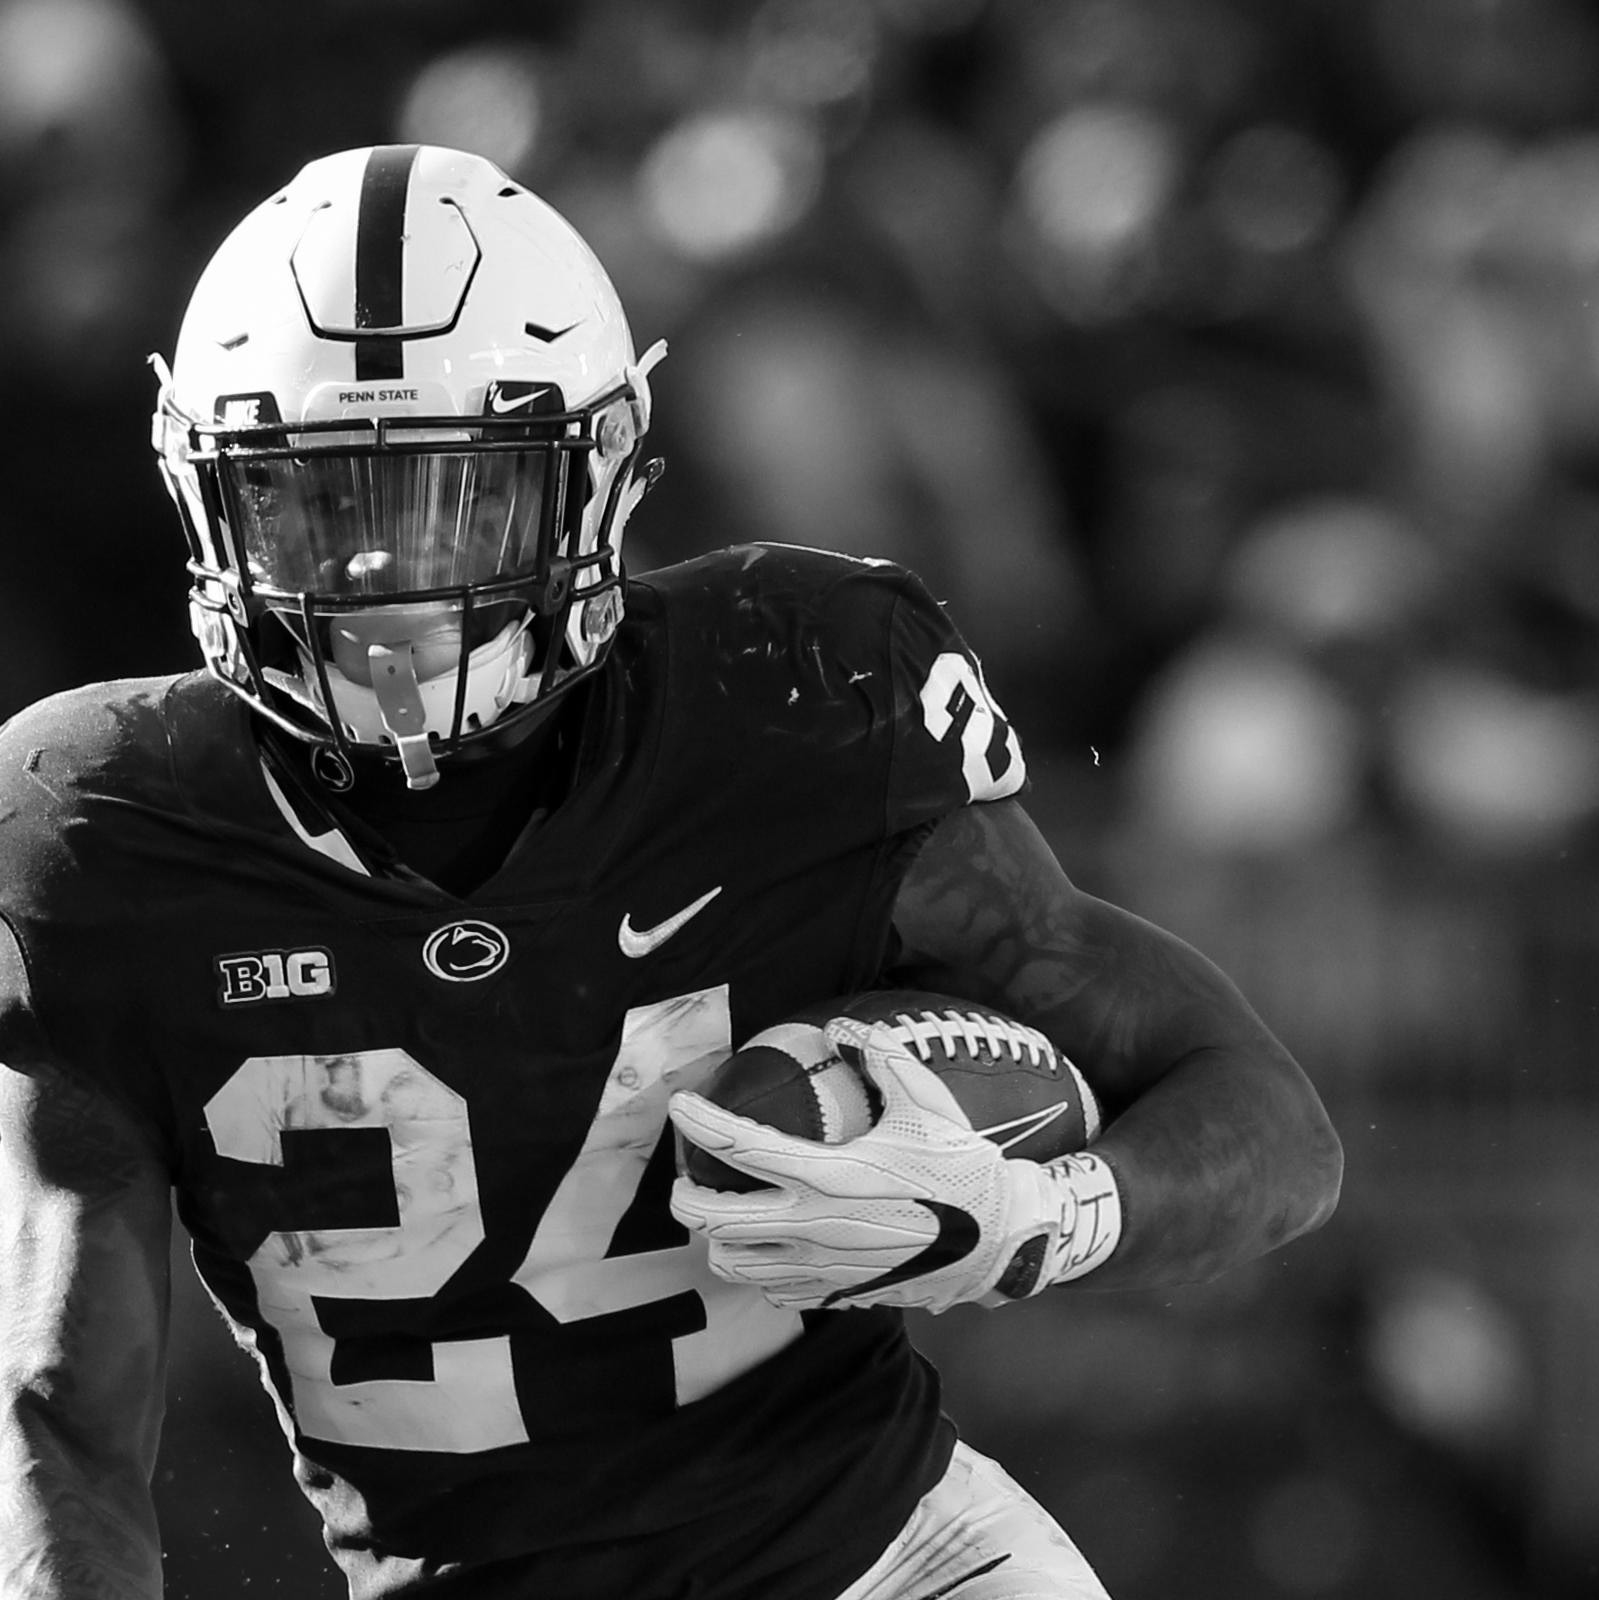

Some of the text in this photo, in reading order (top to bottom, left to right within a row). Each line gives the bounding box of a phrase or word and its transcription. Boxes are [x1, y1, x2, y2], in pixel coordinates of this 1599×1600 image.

[338, 389, 419, 403] PENN STATE
[919, 650, 1027, 805] 2
[203, 983, 805, 1454] 24
